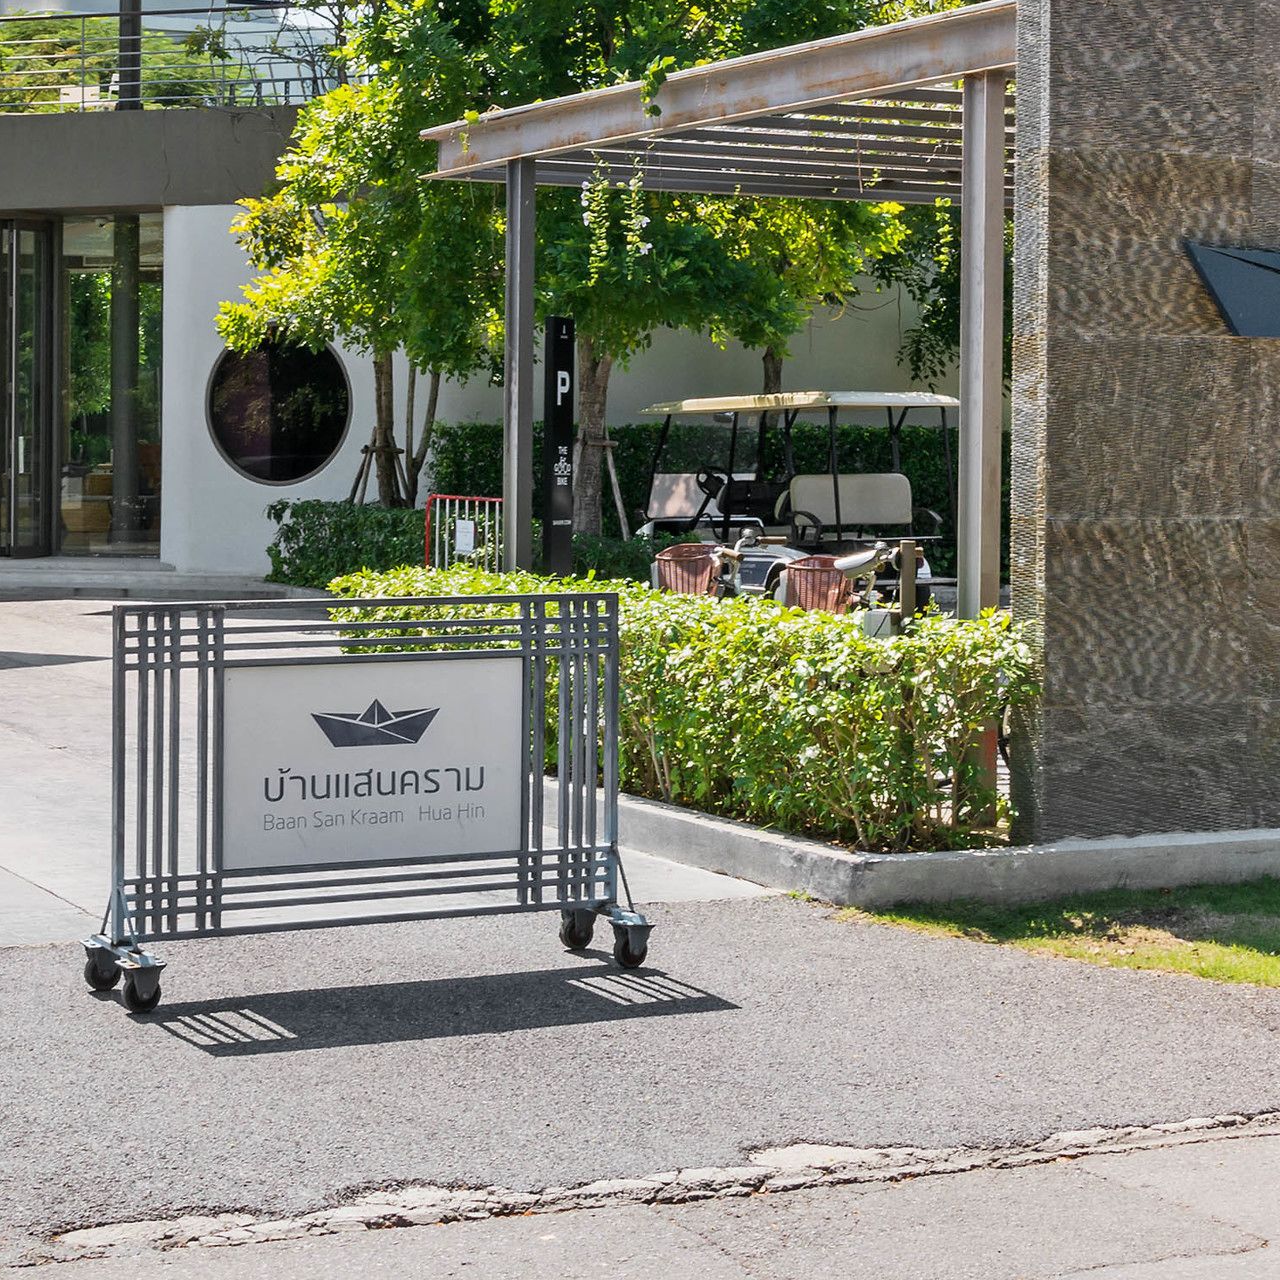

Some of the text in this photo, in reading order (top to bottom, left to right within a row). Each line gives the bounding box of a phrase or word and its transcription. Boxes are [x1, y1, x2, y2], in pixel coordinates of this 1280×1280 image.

[556, 370, 570, 406] P
[263, 766, 485, 802] บ้านแสนคราม
[263, 802, 485, 831] Baan San Kraam Hua Hin
